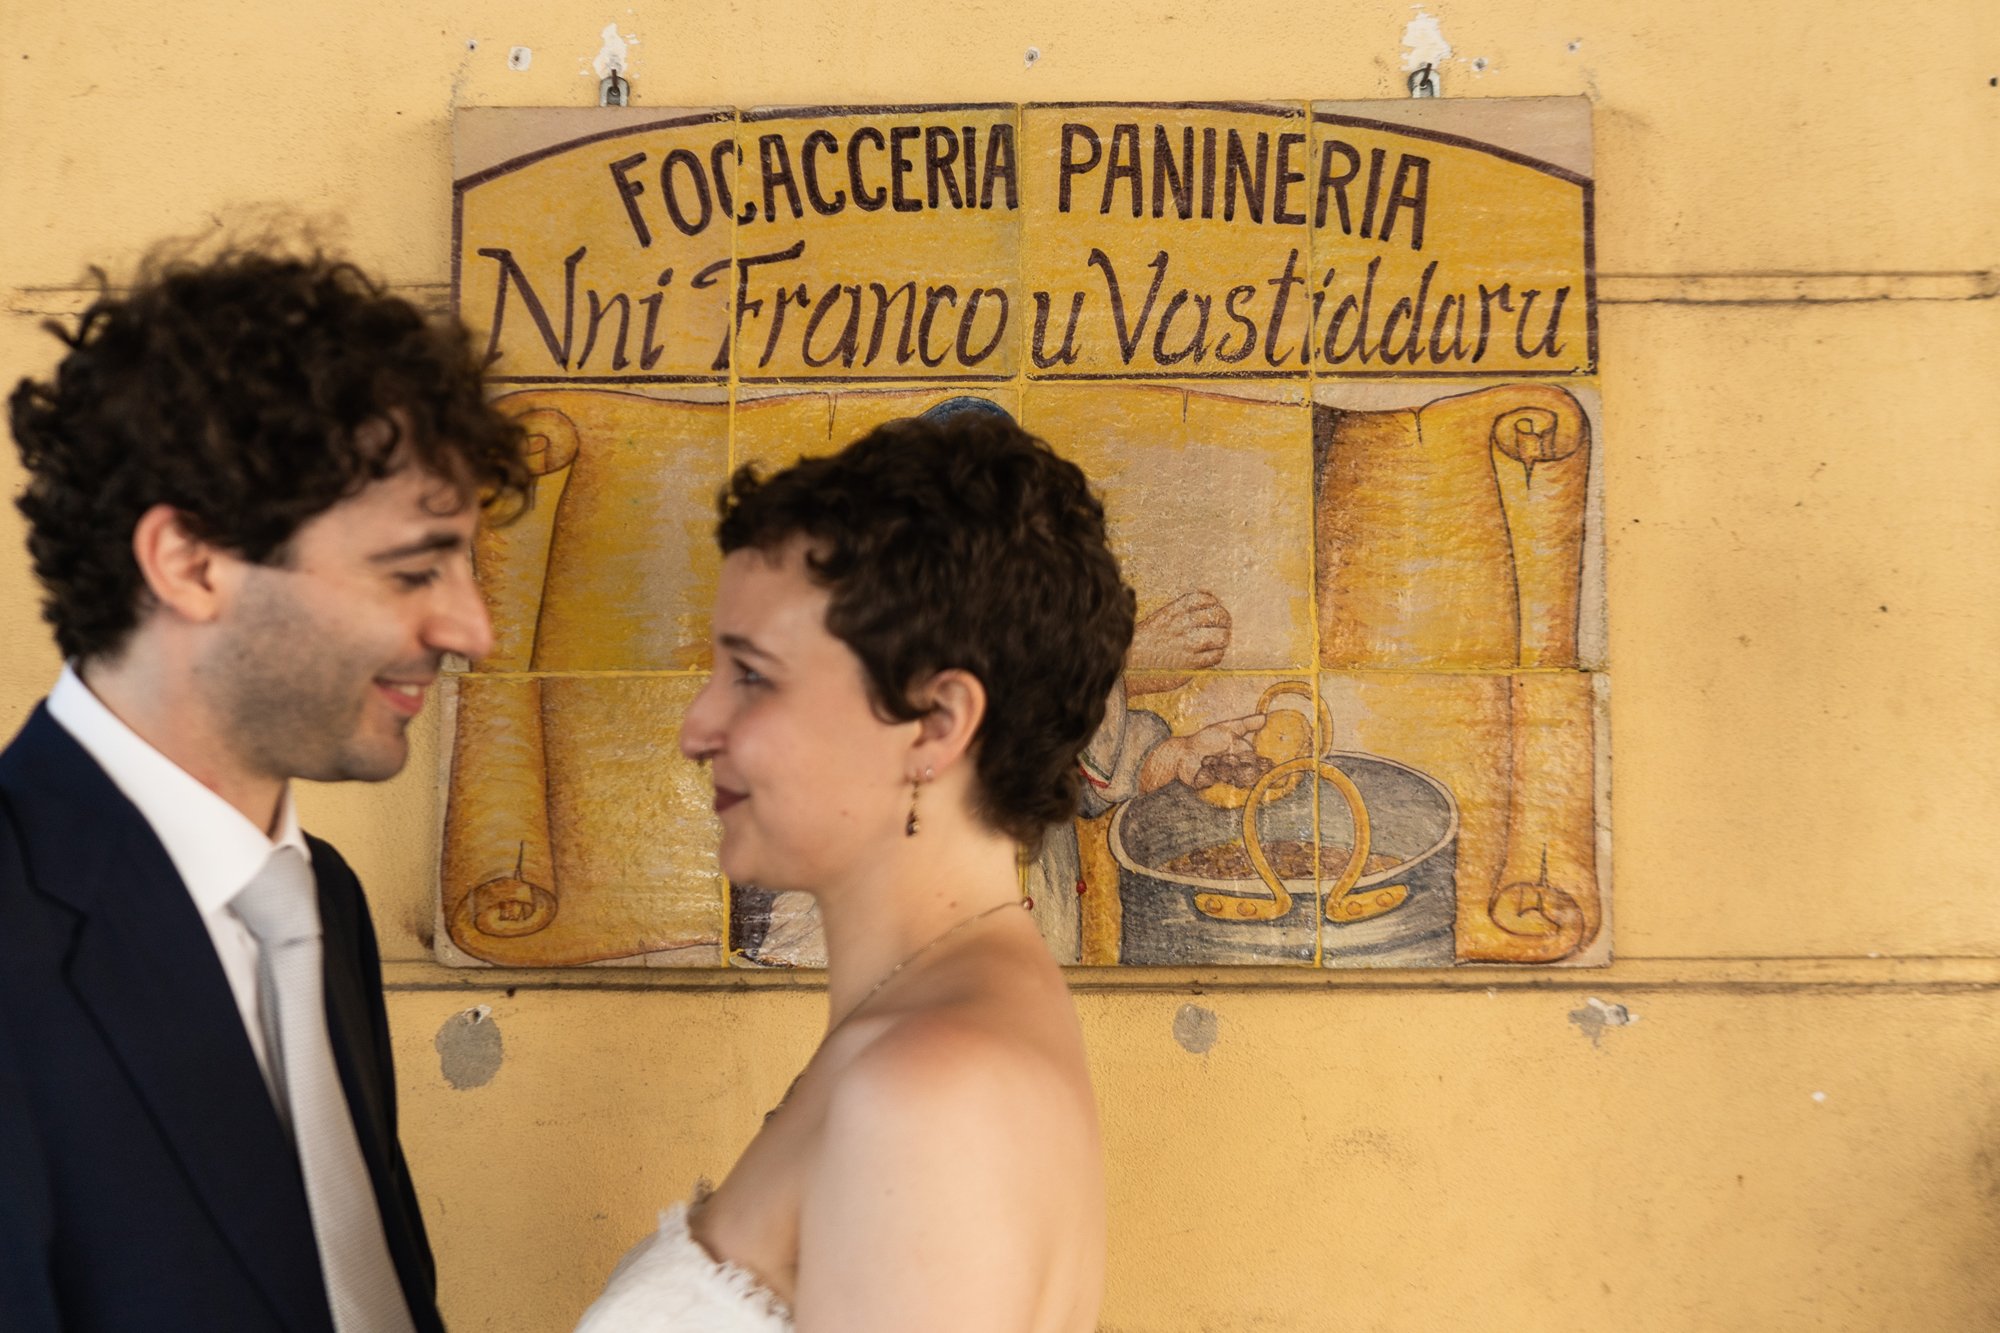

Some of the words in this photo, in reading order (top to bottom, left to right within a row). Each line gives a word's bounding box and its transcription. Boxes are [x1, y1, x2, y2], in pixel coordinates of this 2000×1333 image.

[608, 123, 1019, 248] FOCACCERIA
[1058, 122, 1431, 251] PANINERIA
[477, 245, 674, 372] Nni
[690, 239, 1009, 371] Franco
[1032, 290, 1086, 369] u
[1087, 247, 1571, 368] Vastiddaru
